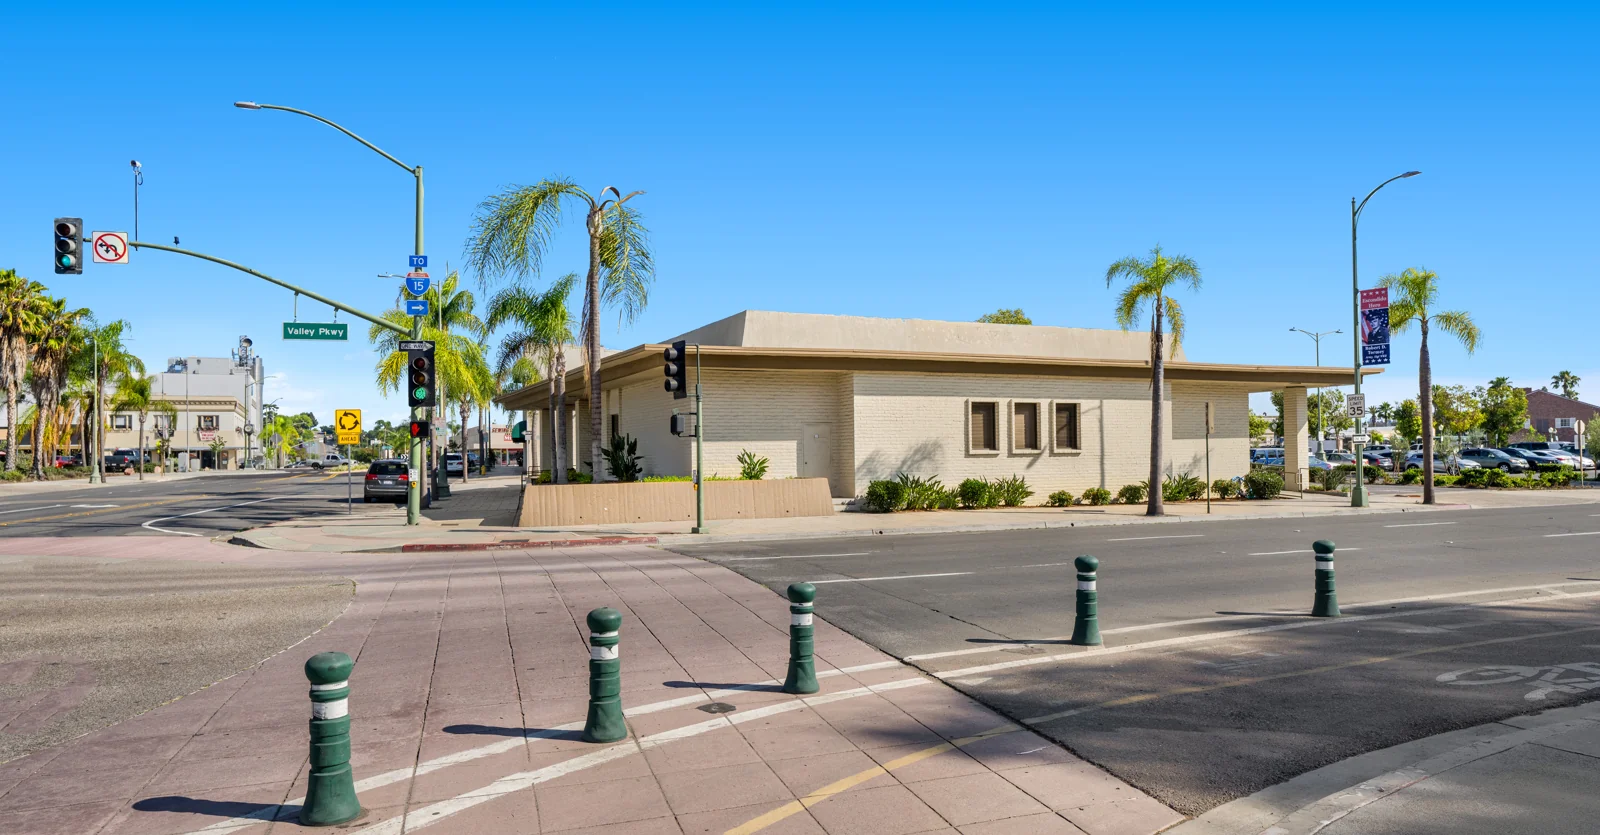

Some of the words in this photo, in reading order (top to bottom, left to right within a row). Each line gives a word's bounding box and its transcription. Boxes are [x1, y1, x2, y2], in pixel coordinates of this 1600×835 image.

[412, 257, 425, 265] TO
[413, 281, 424, 291] 15
[287, 327, 315, 337] Valley
[319, 328, 344, 338] Pkwy
[1350, 406, 1363, 416] 35
